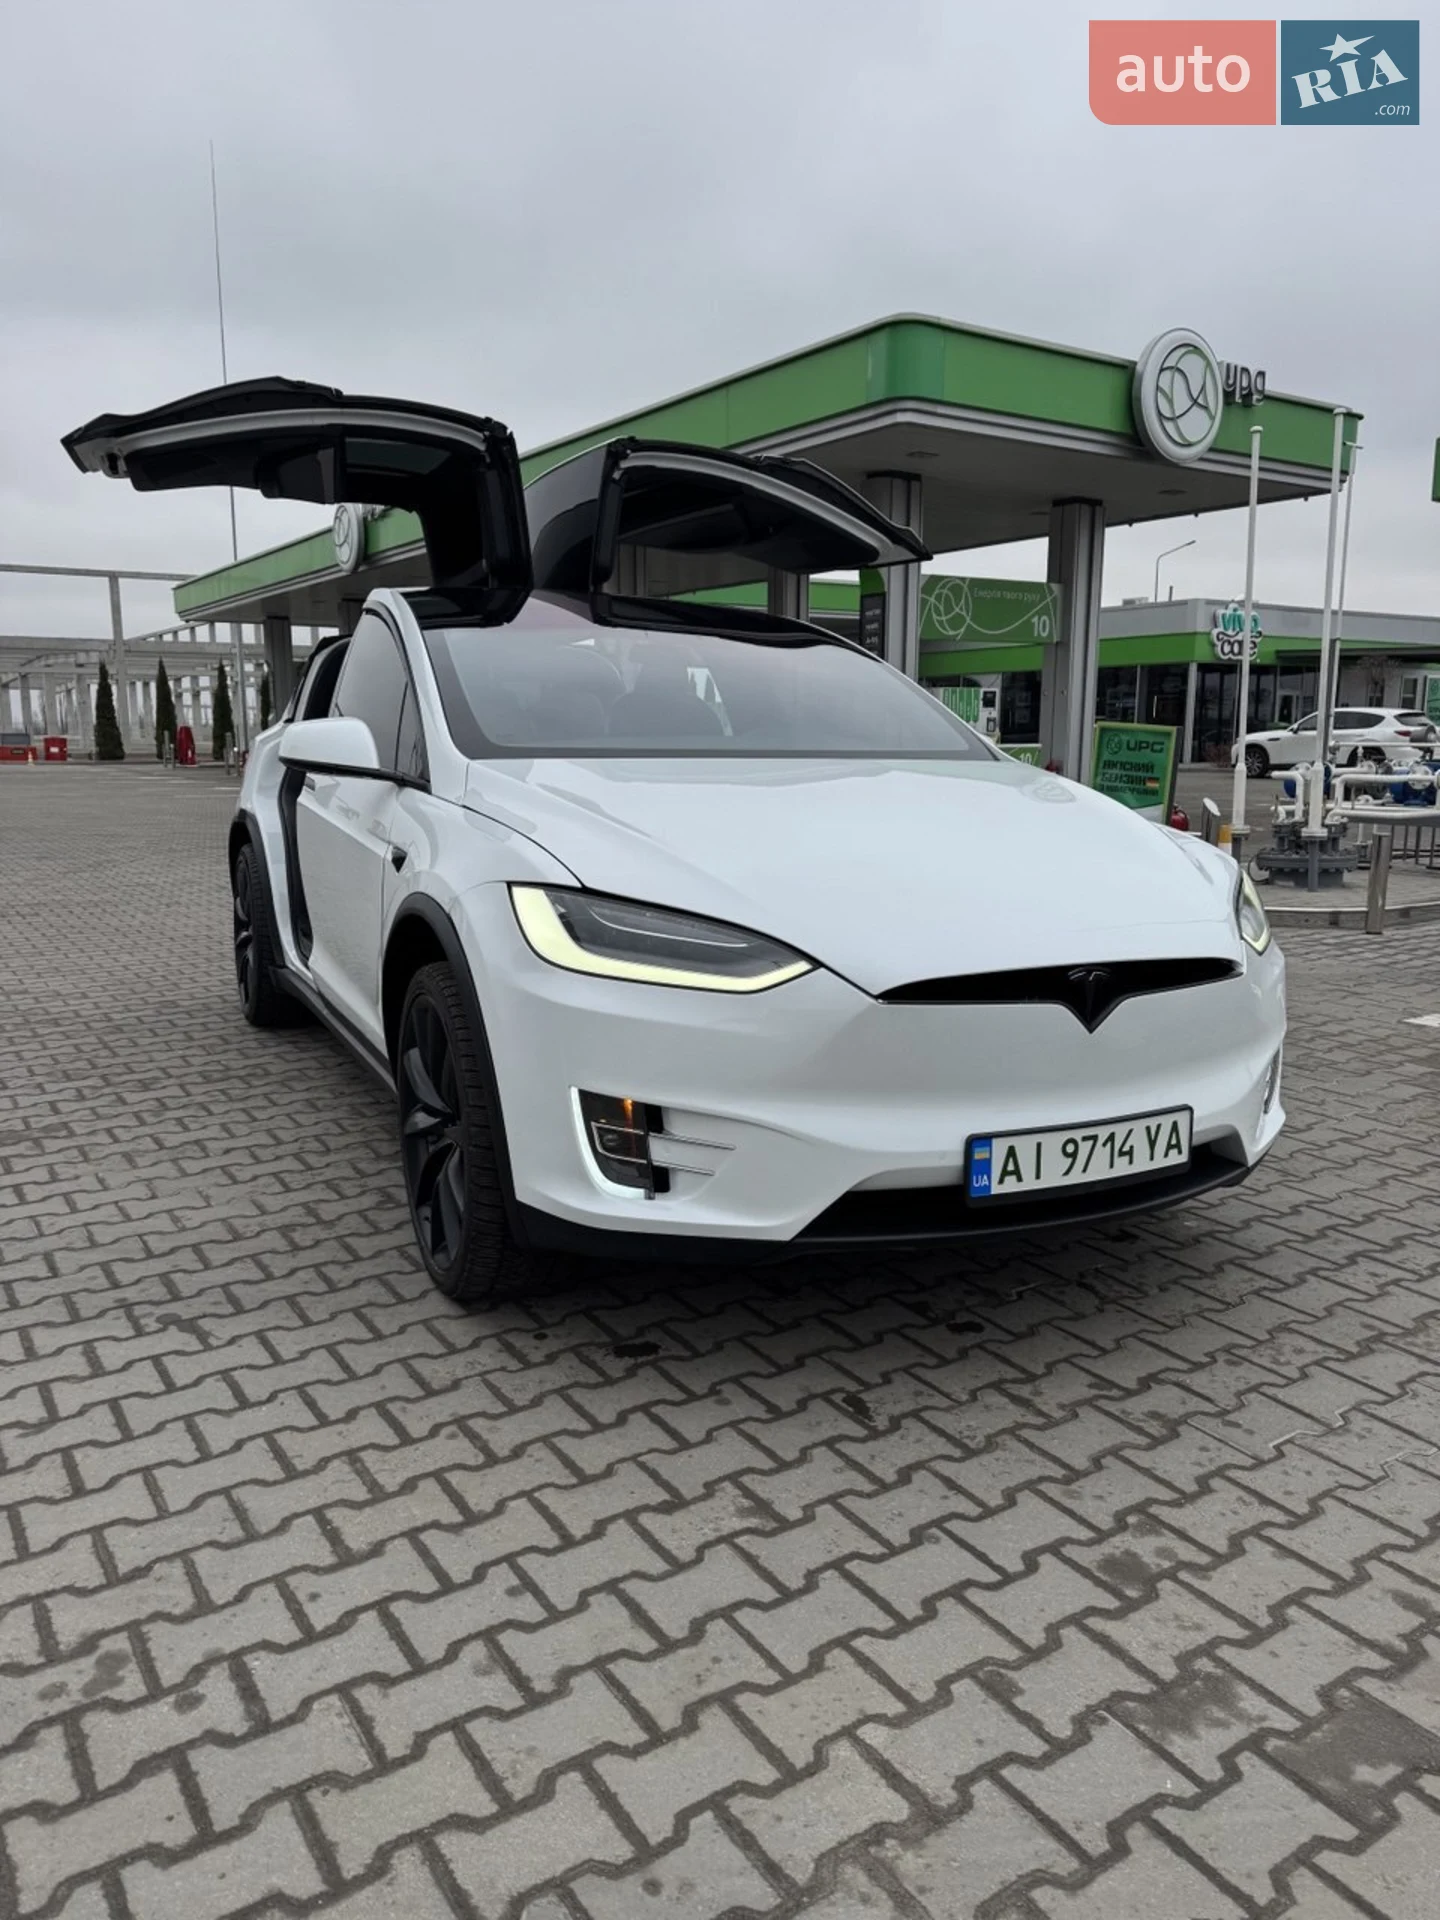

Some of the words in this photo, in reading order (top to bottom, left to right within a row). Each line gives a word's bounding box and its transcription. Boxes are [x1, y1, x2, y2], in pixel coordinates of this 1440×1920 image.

[1223, 361, 1267, 406] upg
[1032, 615, 1050, 637] 10
[1126, 740, 1165, 754] UPG
[997, 1141, 1042, 1185] AI
[1061, 1128, 1135, 1177] 9714
[1145, 1120, 1183, 1162] YA
[972, 1175, 990, 1188] UA
